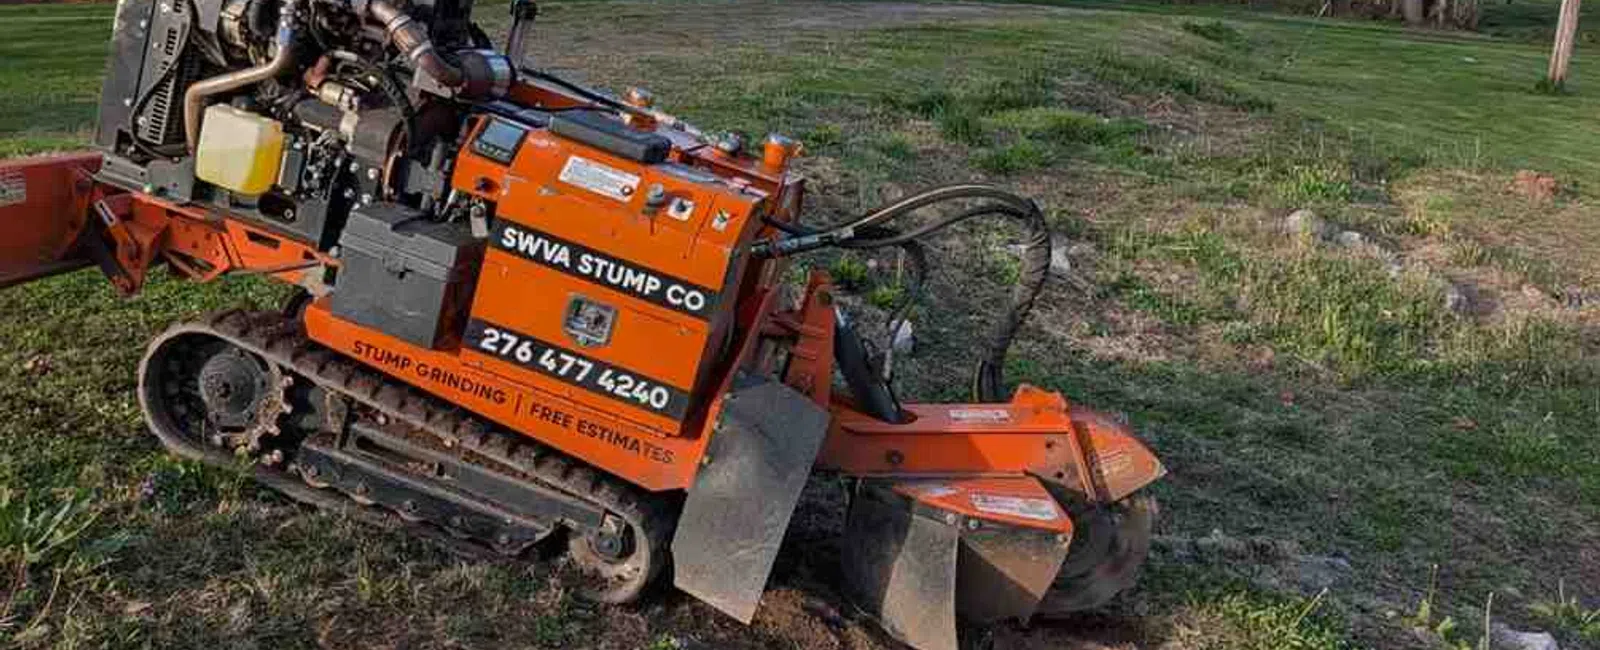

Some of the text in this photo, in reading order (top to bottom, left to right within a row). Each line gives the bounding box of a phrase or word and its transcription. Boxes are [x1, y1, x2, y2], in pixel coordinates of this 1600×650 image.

[501, 226, 705, 311] SWVA STUMP CO
[353, 340, 676, 464] STUMP GRINDING FREE ESTIMATES
[480, 327, 669, 410] 276 477 4240
